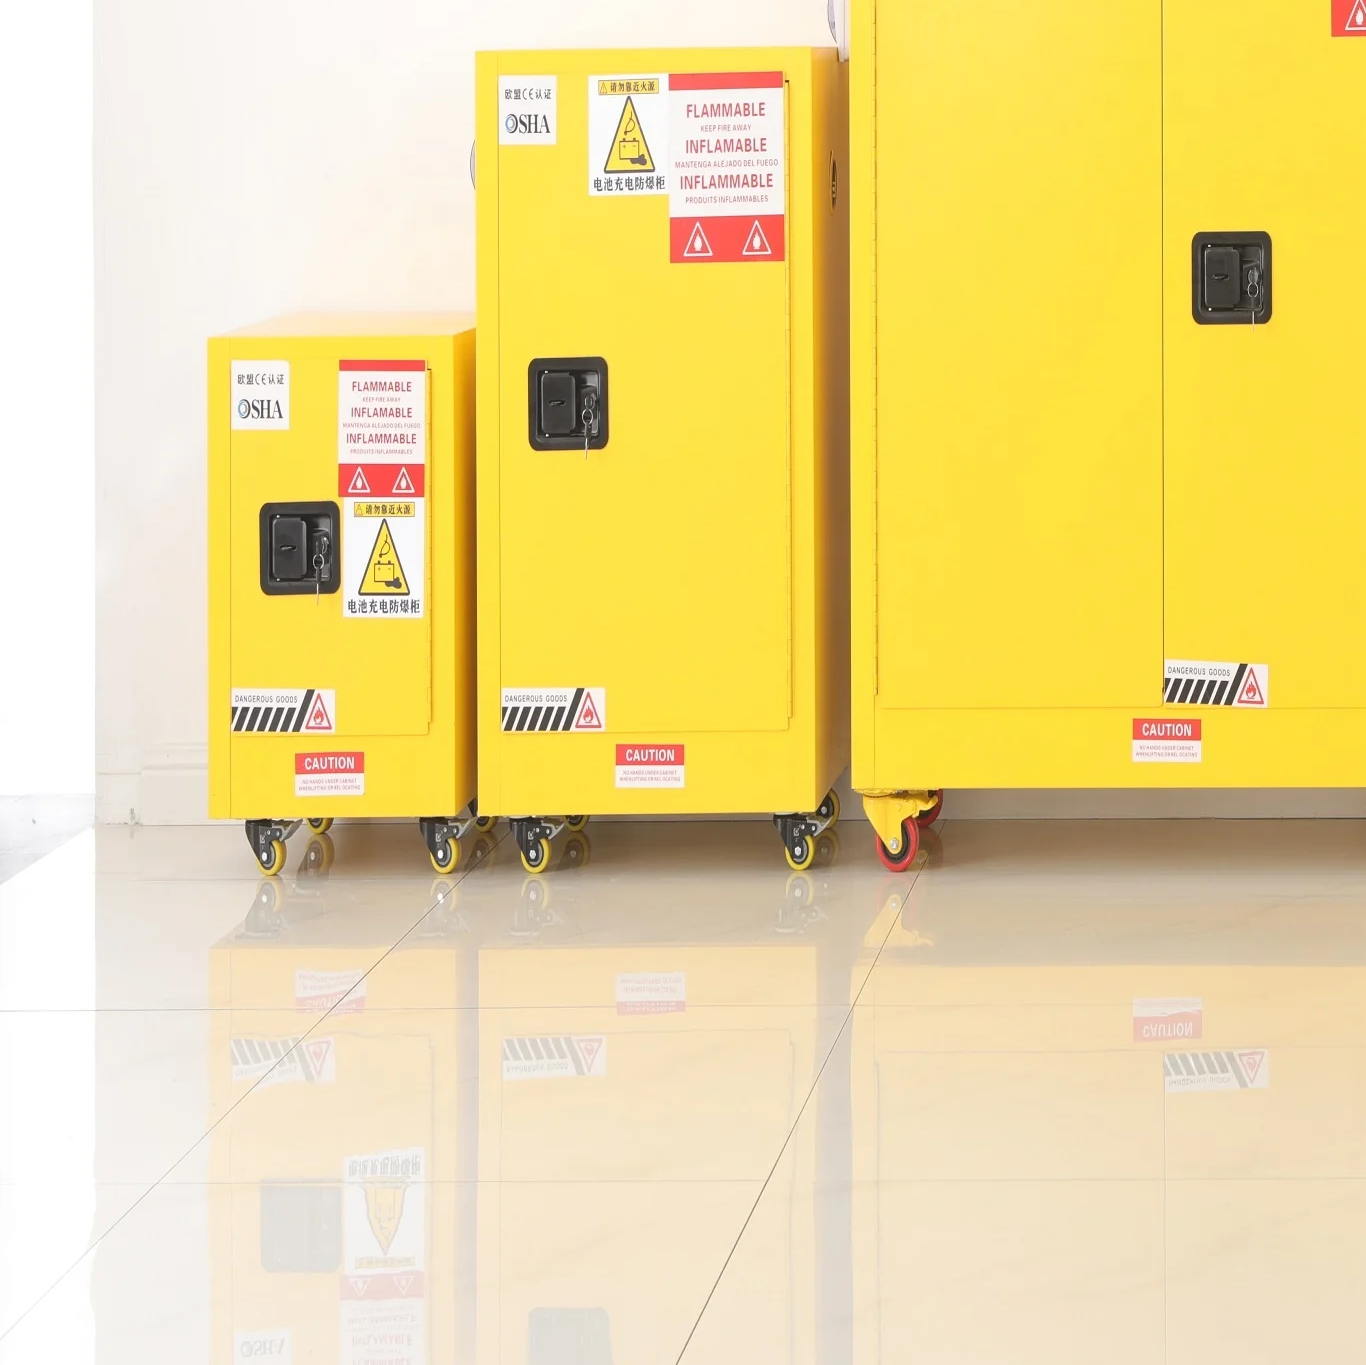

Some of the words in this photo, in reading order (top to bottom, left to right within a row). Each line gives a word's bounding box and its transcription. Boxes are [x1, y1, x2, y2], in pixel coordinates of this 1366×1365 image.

[610, 81, 655, 93] 请勿靠近火源
[686, 102, 765, 118] FLAMMABLE
[505, 113, 550, 134] OSHA
[686, 138, 767, 153] INFLAMABLE
[675, 160, 712, 168] MANTENGA
[713, 159, 742, 167] ALEJADO
[593, 175, 665, 192] 电池充电防爆柜
[680, 173, 773, 189] INFLAMMABLE
[685, 196, 718, 204] PRODUITS
[719, 195, 768, 203] INFLAMMABLES
[352, 382, 411, 392] FLAMMABLE
[238, 399, 283, 419] OSHA
[351, 407, 412, 418] INFLAMABLE
[347, 433, 417, 444] INFLAMMABLE
[366, 504, 411, 515] 请勿靠近火源
[347, 599, 420, 614] 电池充电防爆柜
[1168, 666, 1206, 675] DANGEROUS
[235, 695, 273, 703] DANGEROUS
[1142, 723, 1192, 736] CAUTION
[626, 749, 674, 762] CAUTION
[304, 757, 354, 770] CAUTION
